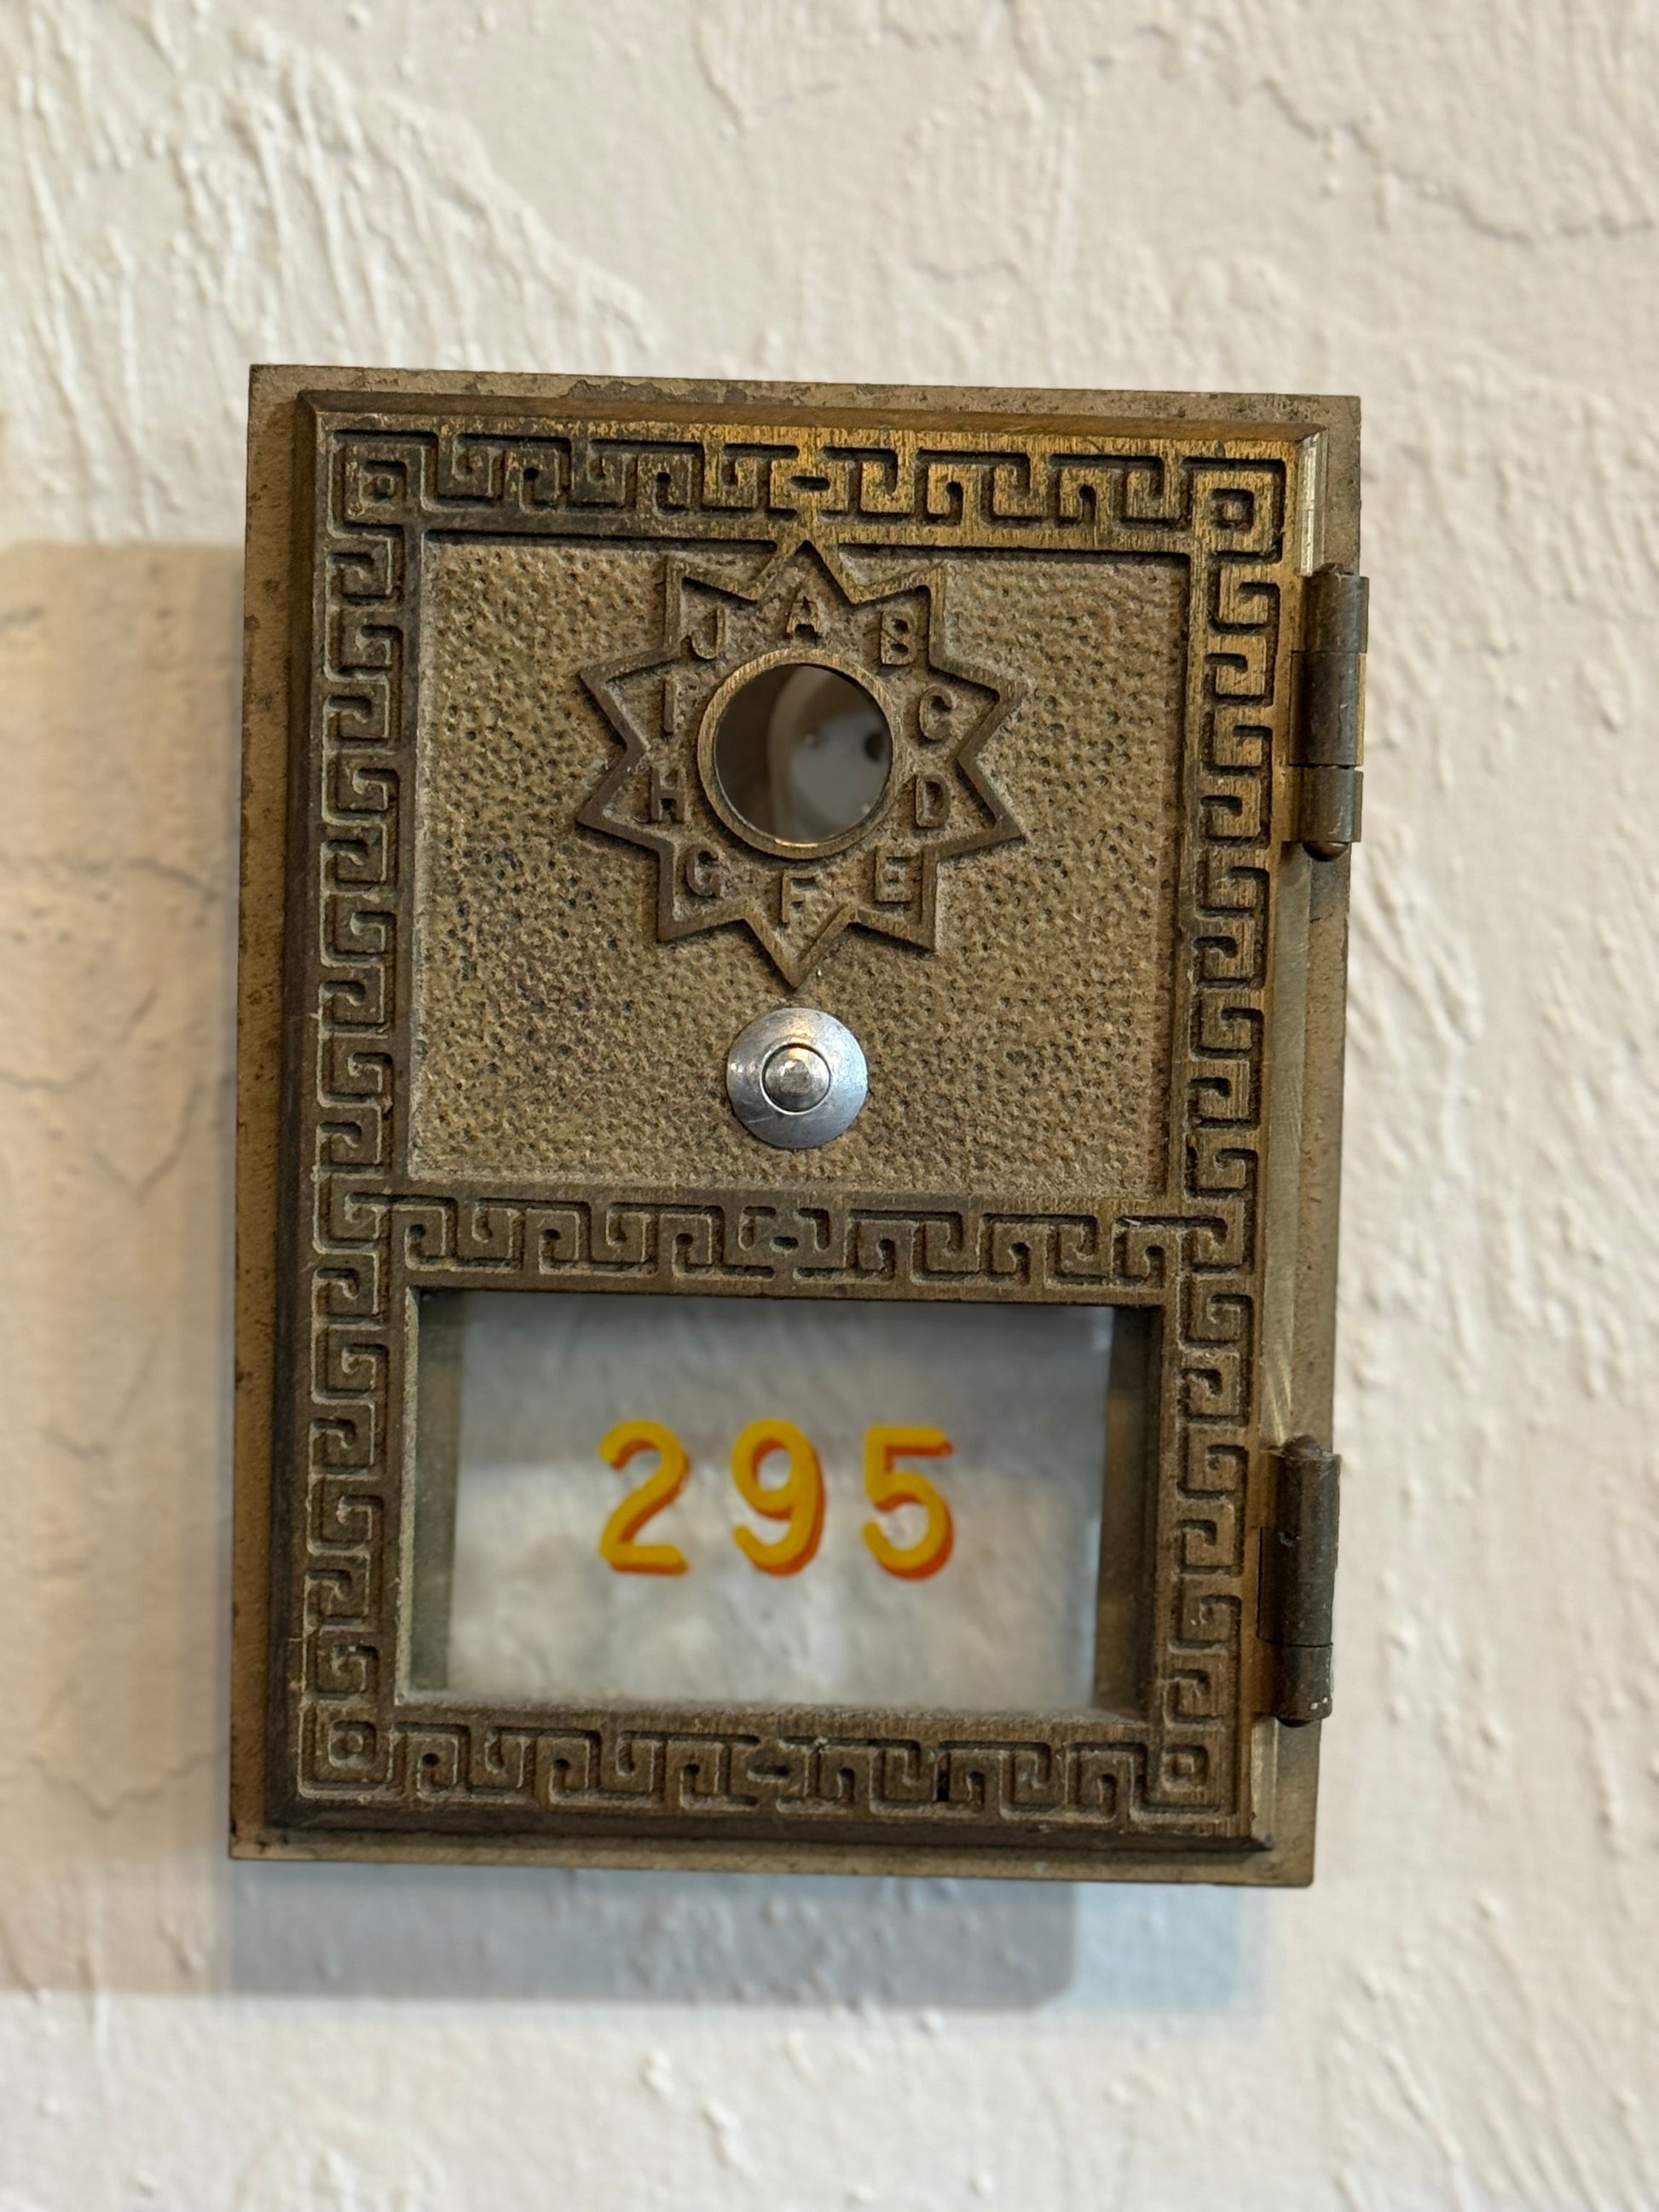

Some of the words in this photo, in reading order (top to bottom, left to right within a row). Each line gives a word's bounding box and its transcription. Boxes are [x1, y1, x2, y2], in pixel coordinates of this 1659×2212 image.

[690, 606, 726, 660] J
[786, 592, 823, 639] A
[880, 610, 918, 666] B
[918, 686, 954, 741] C
[650, 767, 683, 823] H
[915, 773, 951, 829] D
[781, 869, 819, 924] F
[875, 852, 910, 904] E
[598, 1419, 954, 1580] 295
